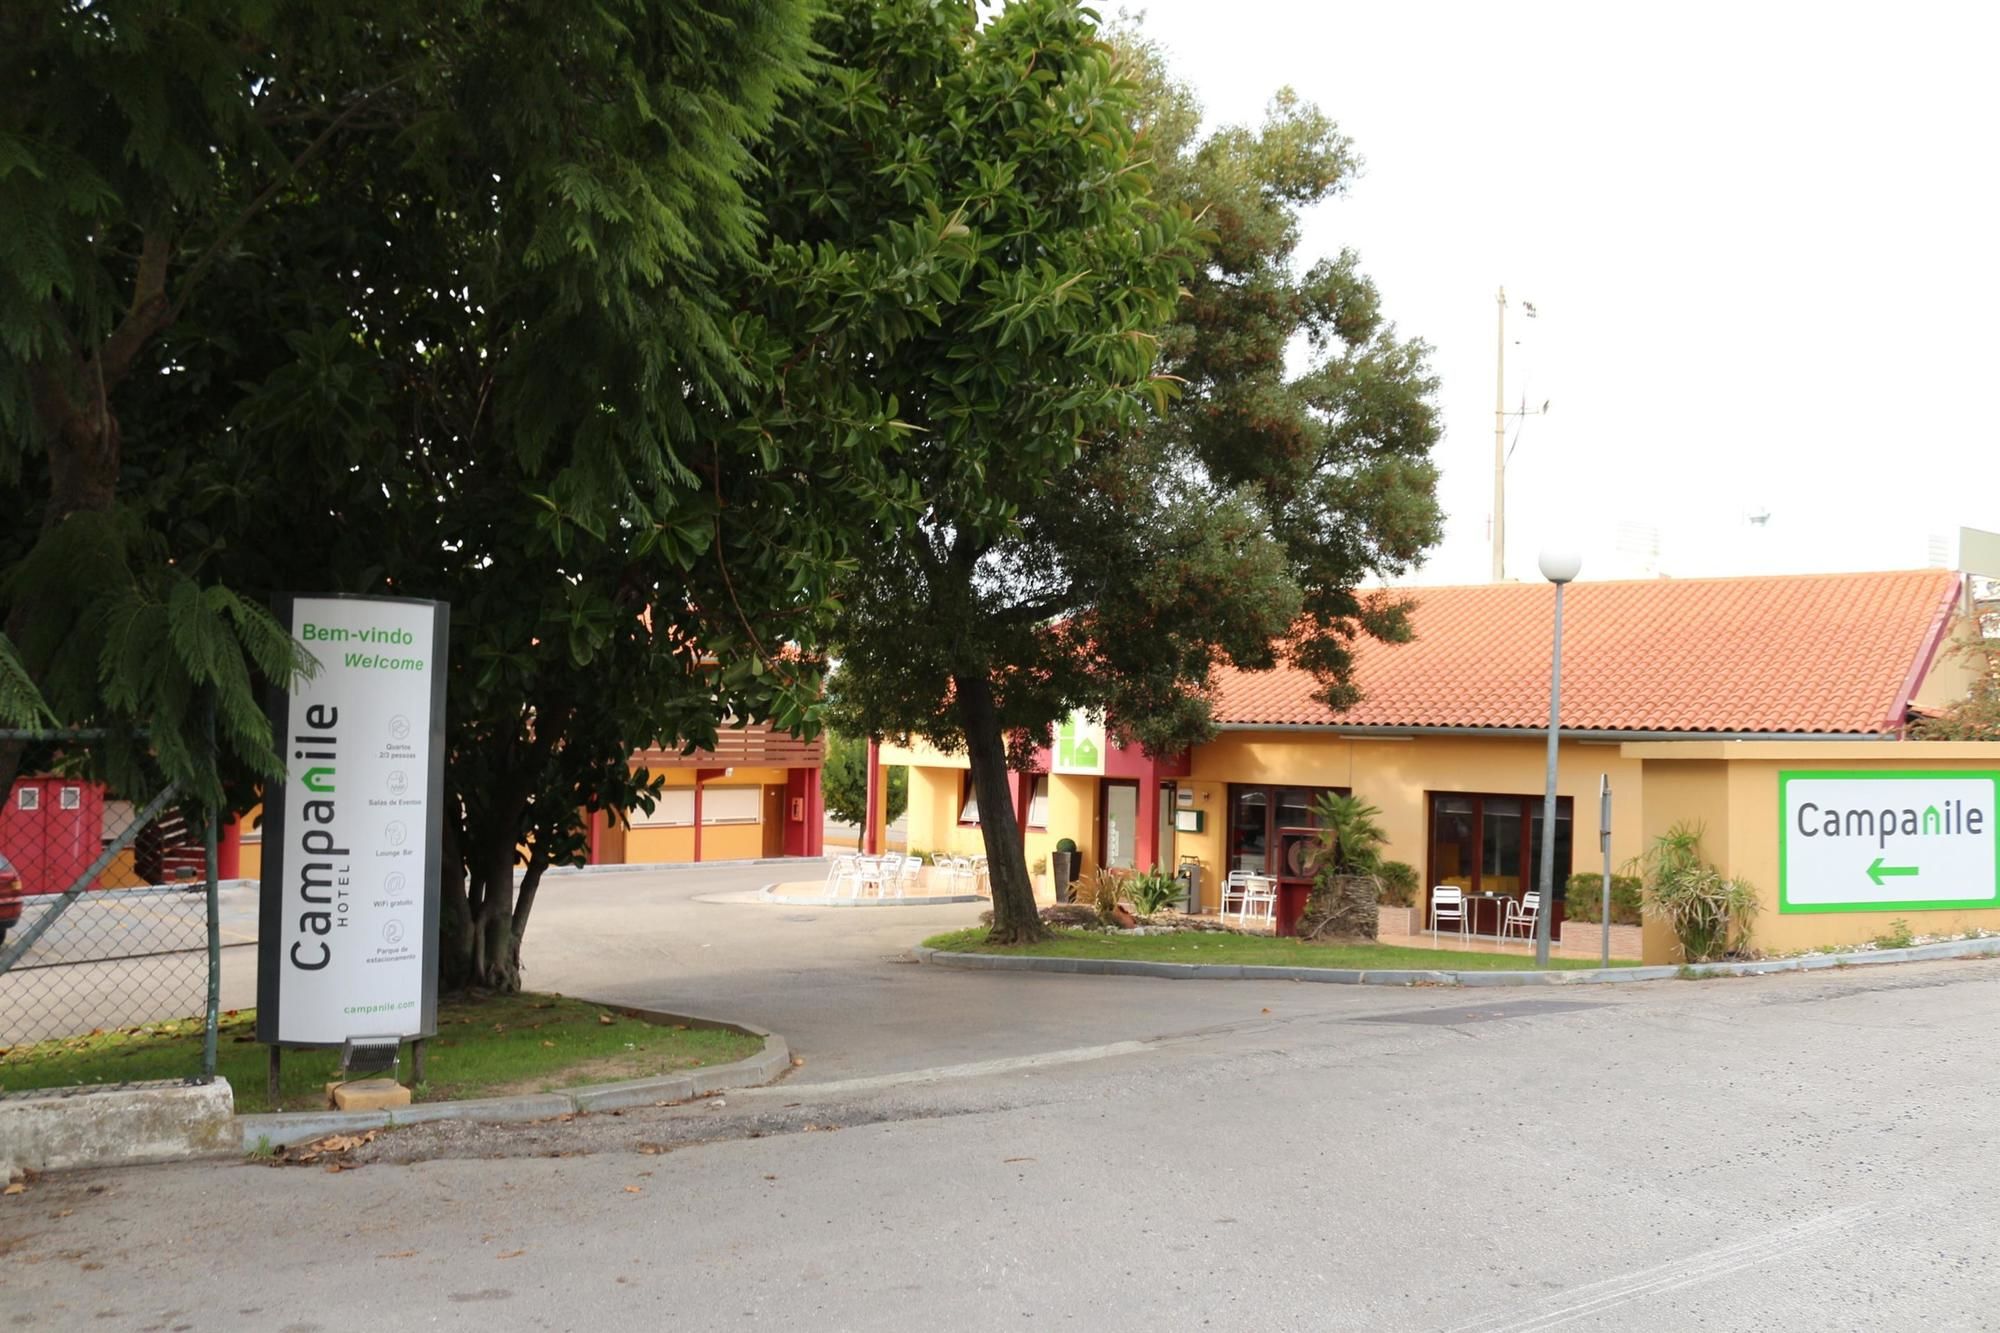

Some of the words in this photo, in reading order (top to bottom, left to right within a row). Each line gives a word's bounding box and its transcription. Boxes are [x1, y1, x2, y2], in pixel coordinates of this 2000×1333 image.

[303, 623, 413, 645] Bem-vindo
[345, 653, 424, 671] Welcome
[1797, 799, 1983, 850] Campanile
[290, 704, 350, 971] Campanile
[376, 849, 400, 858] Lounge
[337, 864, 350, 928] HOTEL
[377, 947, 399, 956] Parque
[344, 1000, 415, 1015] campanile.com
